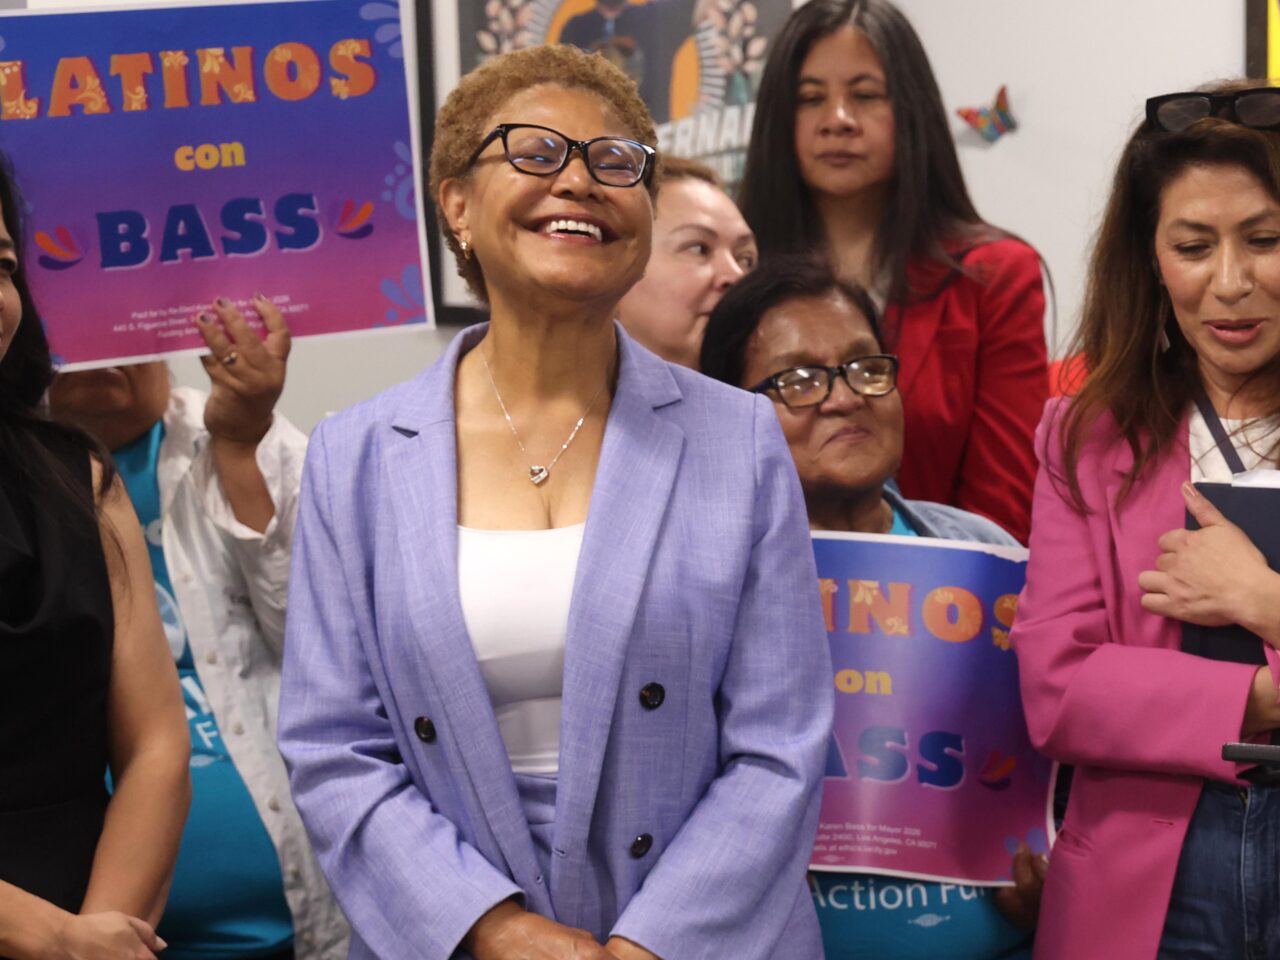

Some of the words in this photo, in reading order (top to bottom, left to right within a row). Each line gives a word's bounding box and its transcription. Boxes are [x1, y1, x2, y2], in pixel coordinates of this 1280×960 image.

[0, 38, 378, 120] LATINOS
[174, 141, 247, 171] con
[97, 192, 323, 271] BASS
[835, 669, 893, 695] on
